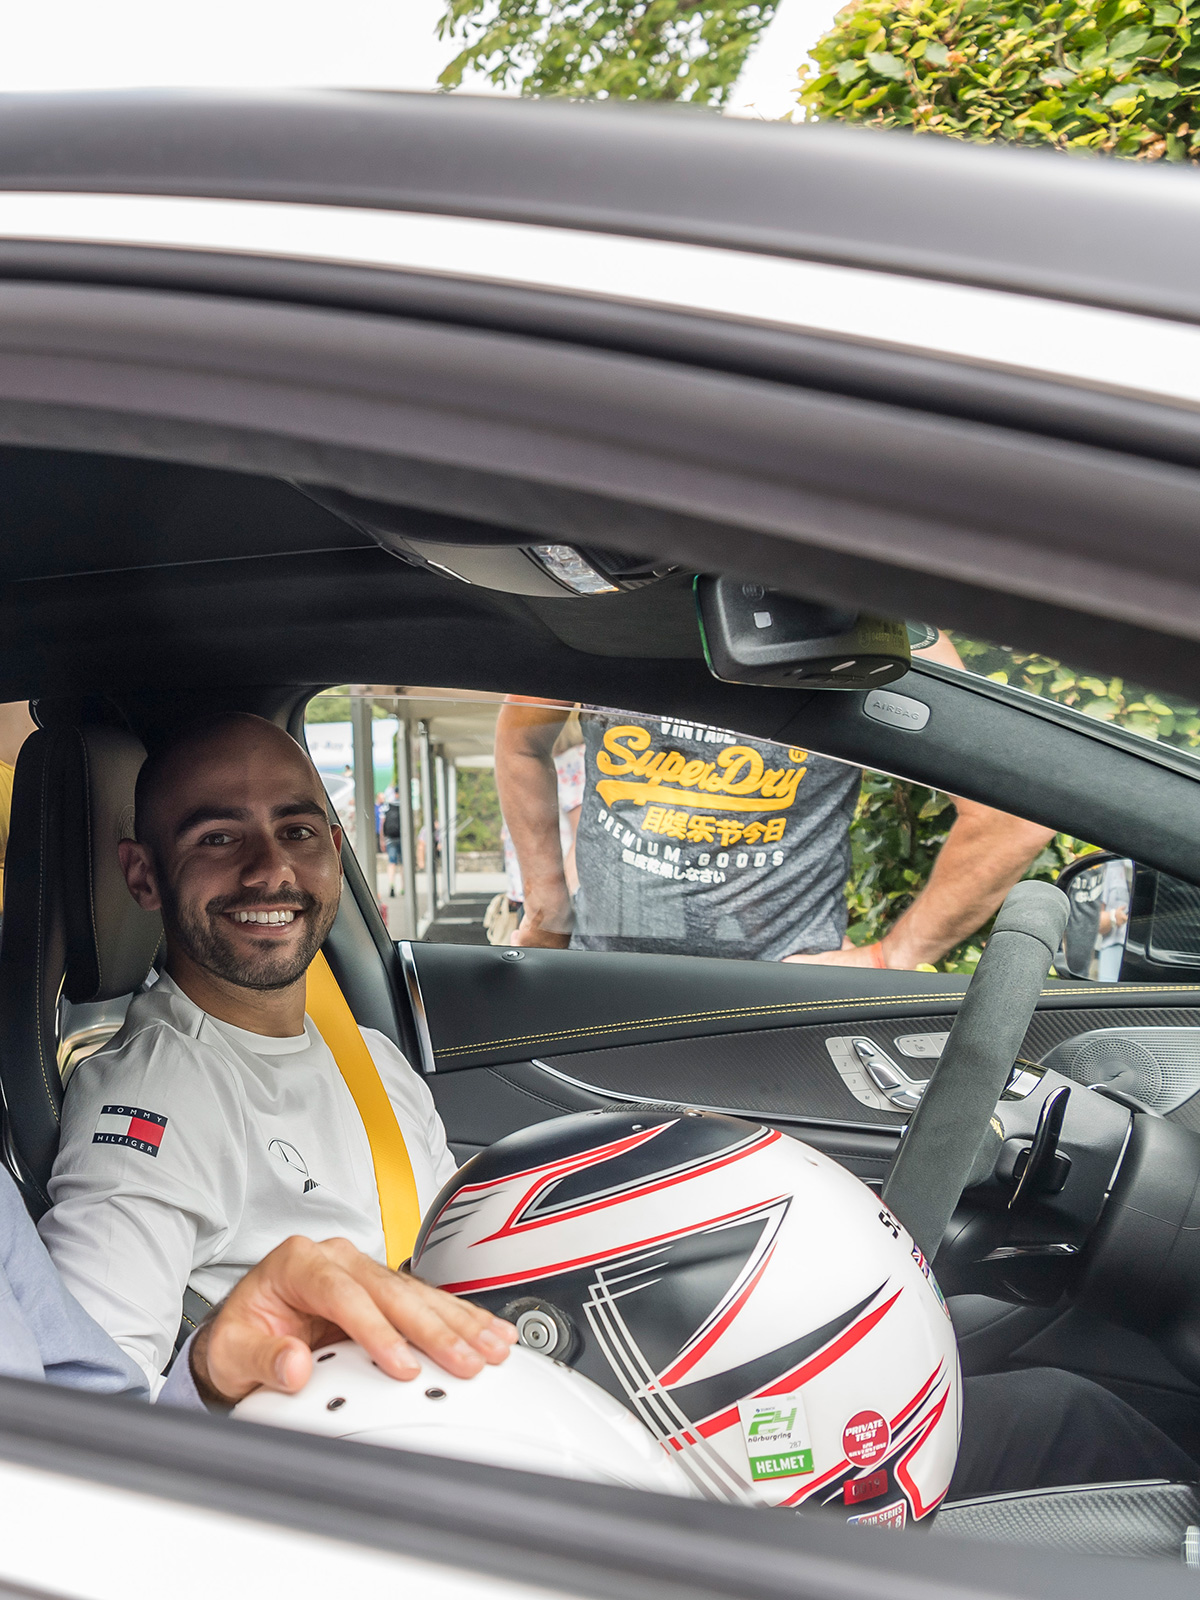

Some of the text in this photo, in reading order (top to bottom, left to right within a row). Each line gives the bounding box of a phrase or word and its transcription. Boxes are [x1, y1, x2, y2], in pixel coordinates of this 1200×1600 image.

[873, 700, 920, 721] AIRBAG
[107, 1106, 162, 1123] TOMMY
[97, 1135, 153, 1153] HILFIGER
[845, 1419, 884, 1437] PRIVATE
[855, 1429, 877, 1442] TEST
[748, 1432, 792, 1443] nürburgring
[756, 1455, 805, 1474] HELMET
[879, 1505, 903, 1523] SERIES
